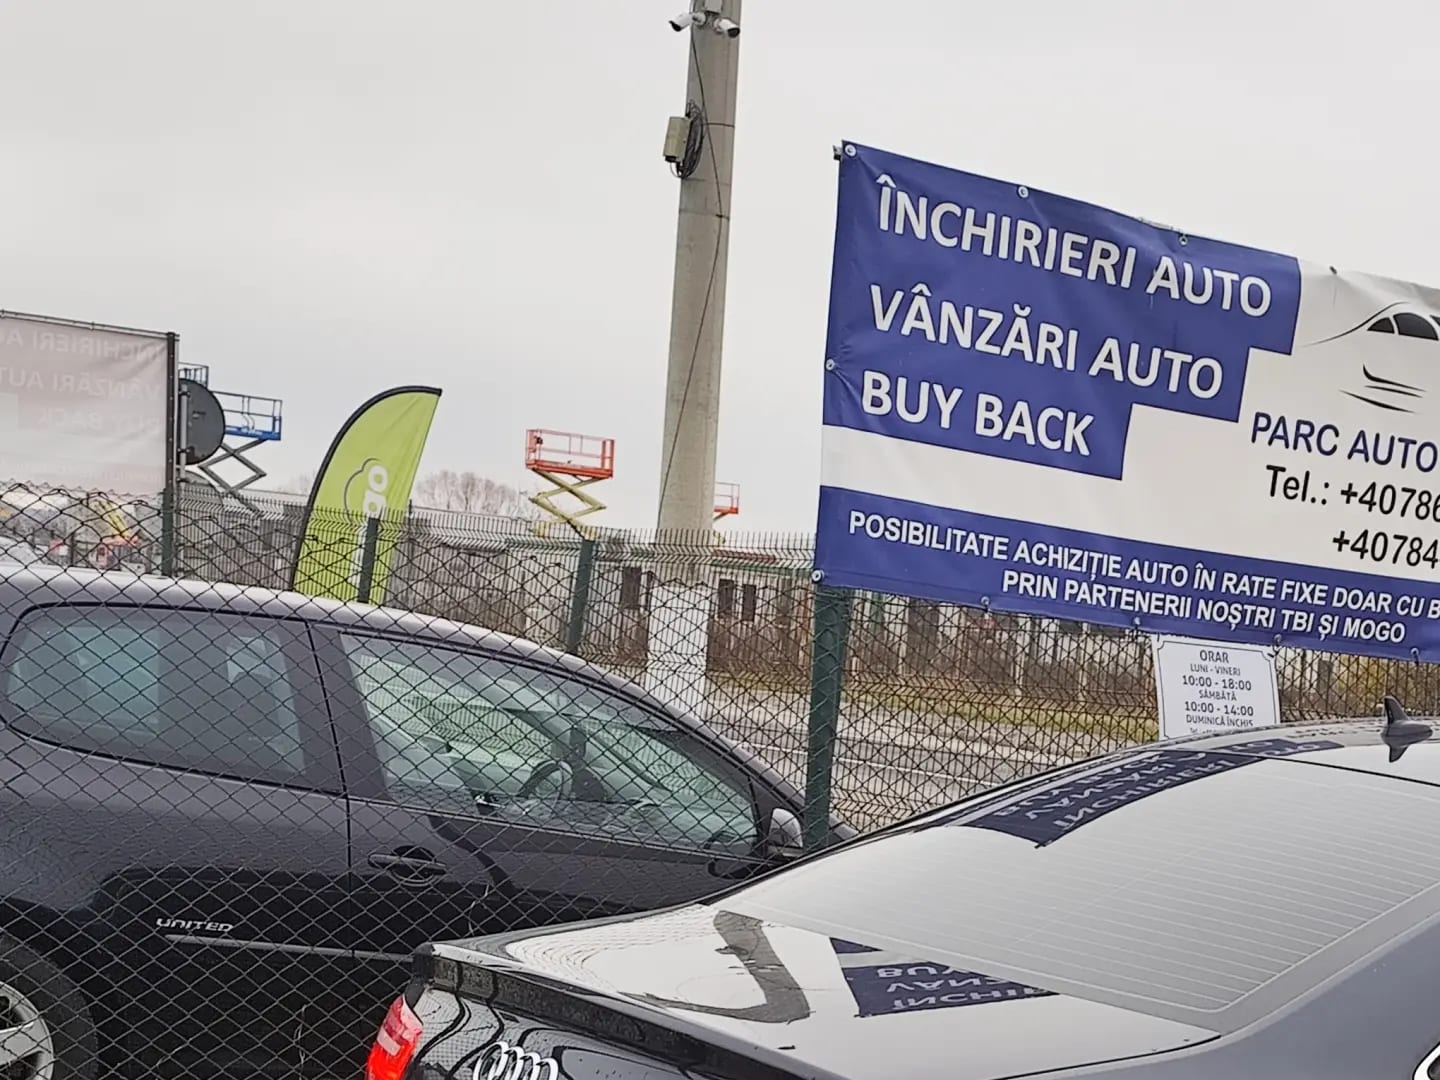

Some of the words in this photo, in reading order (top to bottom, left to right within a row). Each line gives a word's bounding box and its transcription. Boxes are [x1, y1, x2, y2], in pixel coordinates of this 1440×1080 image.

[876, 174, 1137, 289] ÎNCHIRIERI
[1145, 256, 1271, 317] AUTO
[870, 284, 1079, 371] VÂNZĂRI
[1088, 337, 1223, 399] AUTO
[861, 370, 963, 429] BUY
[975, 393, 1094, 456] BACK
[1251, 411, 1339, 456] PARC
[1348, 430, 1438, 472] AUTO
[1266, 464, 1330, 505] Tel.:
[849, 511, 1009, 560] POSIBILITATE
[1013, 541, 1121, 581] ACHIZIȚIE
[1125, 560, 1189, 588] AUTO
[1193, 563, 1216, 591] ÎN
[1221, 571, 1276, 599] RATE
[1280, 580, 1328, 605] FIXE
[1332, 588, 1391, 613] DOAR
[1396, 595, 1424, 616] CU
[1003, 571, 1058, 599] PRIN
[1064, 579, 1192, 619] PARTENERII
[1197, 600, 1275, 632] NOȘTRI
[1281, 610, 1313, 632] TBI
[1319, 616, 1338, 641] ȘI
[1343, 619, 1406, 643] MOGO
[1190, 663, 1208, 673] LUNI
[1200, 650, 1229, 663] ORAR
[1182, 675, 1212, 687] 10:00
[1222, 679, 1251, 691] 18:00
[1184, 701, 1214, 713] 10:00
[1224, 705, 1254, 717] 14:00
[156, 917, 234, 932] UNITED
